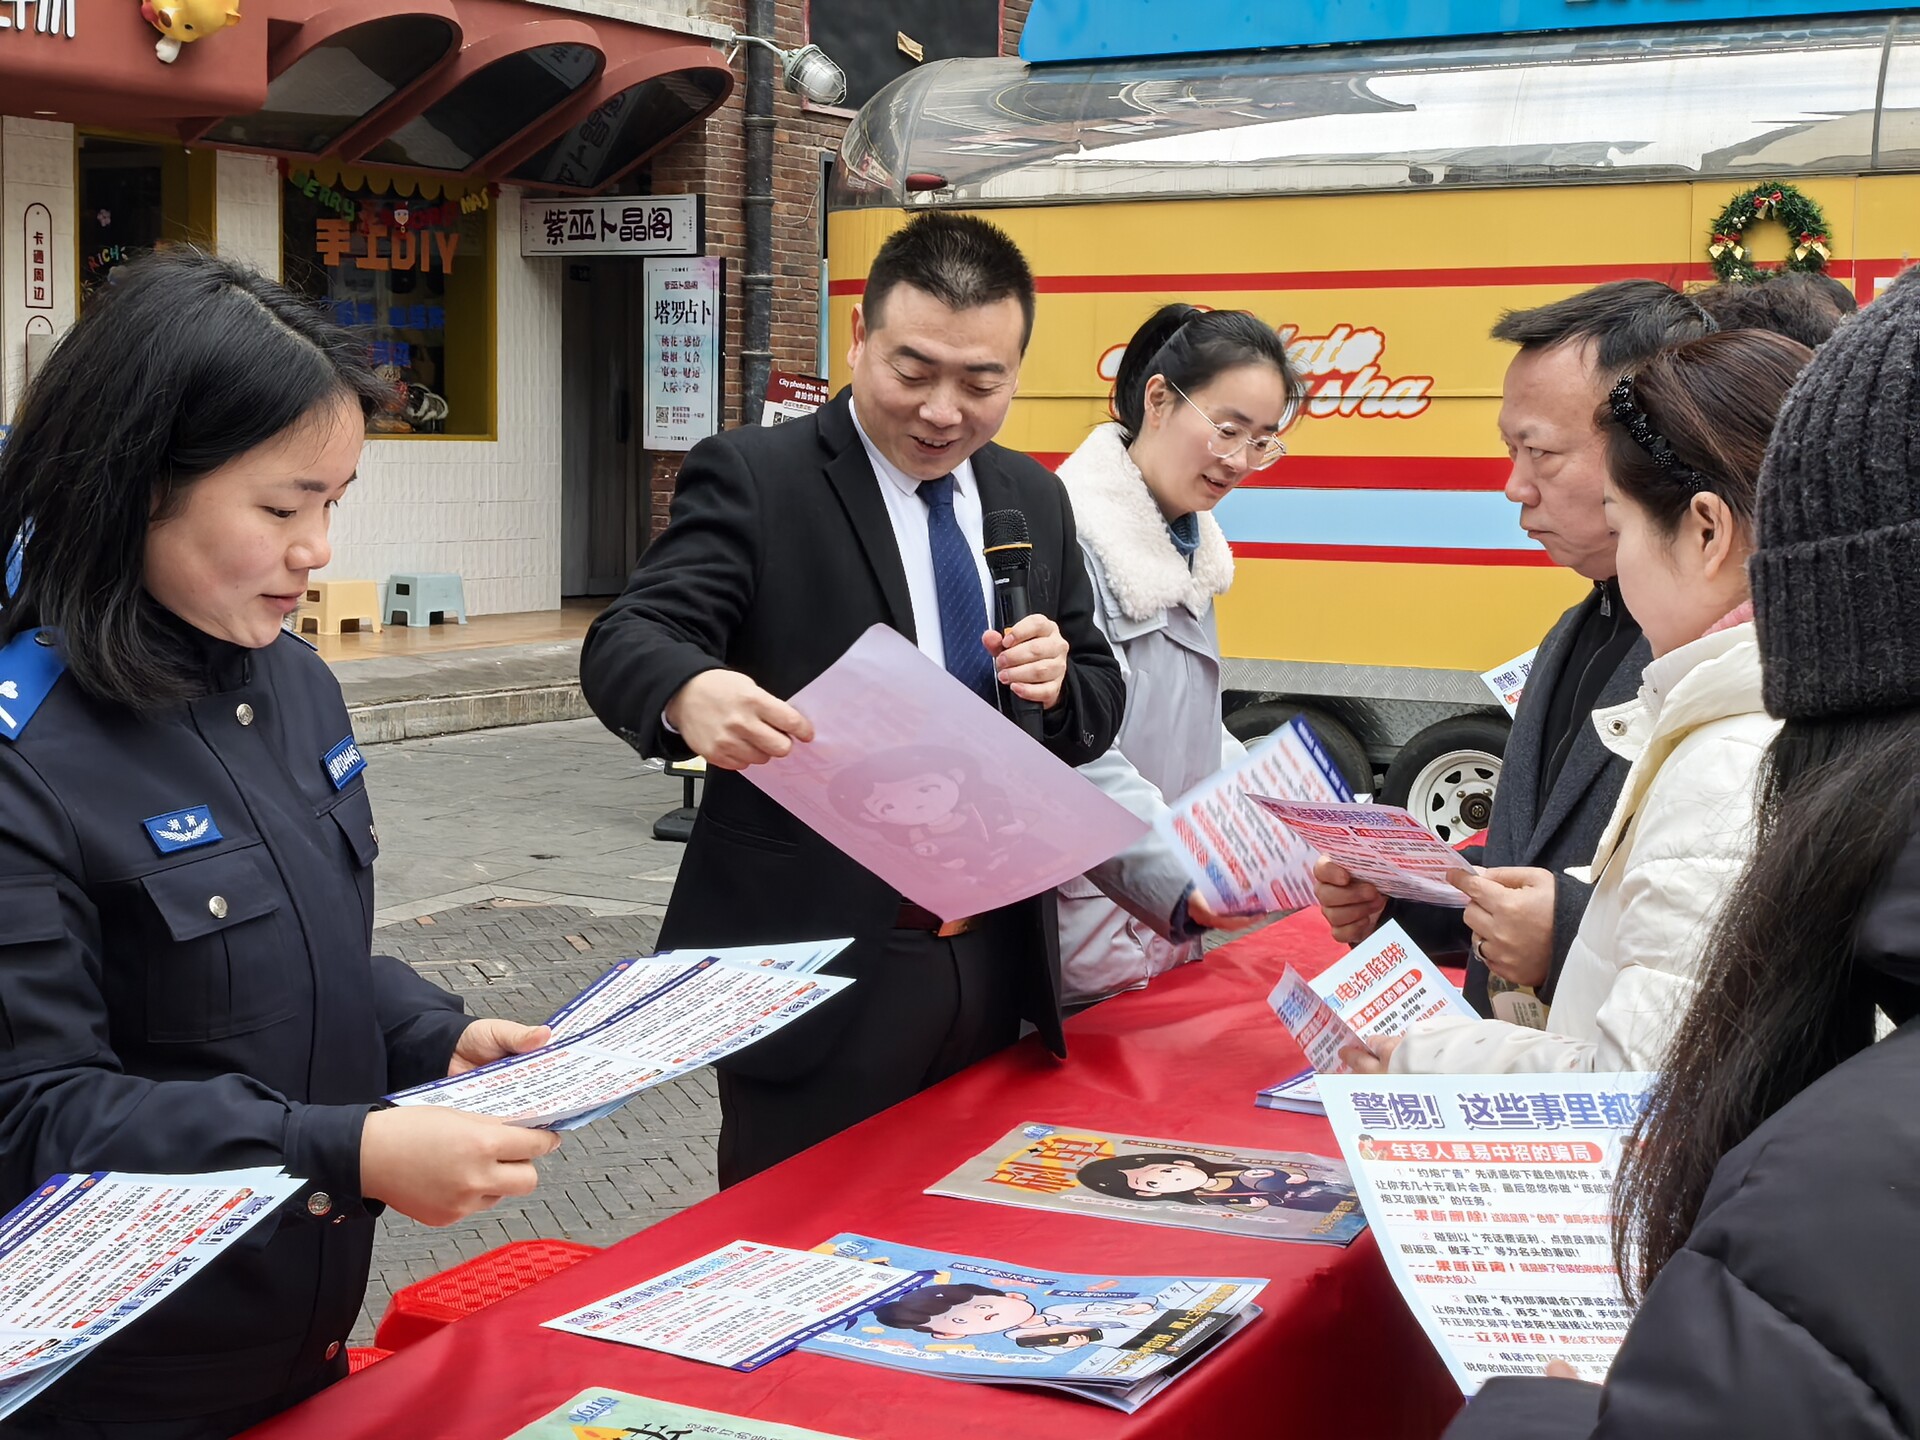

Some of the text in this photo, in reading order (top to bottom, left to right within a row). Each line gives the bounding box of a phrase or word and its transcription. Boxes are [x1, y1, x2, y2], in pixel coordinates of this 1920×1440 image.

[542, 206, 673, 245] 紫巫卜晶阁
[33, 231, 45, 301] 卡通周边
[316, 218, 460, 275] 手工DIY
[655, 299, 711, 325] 塔罗占卜
[1347, 972, 1418, 1030] 易中招的骗局
[1457, 1092, 1650, 1130] 这些事里都
[1390, 1143, 1592, 1162] 年轻人最易中招的骗局
